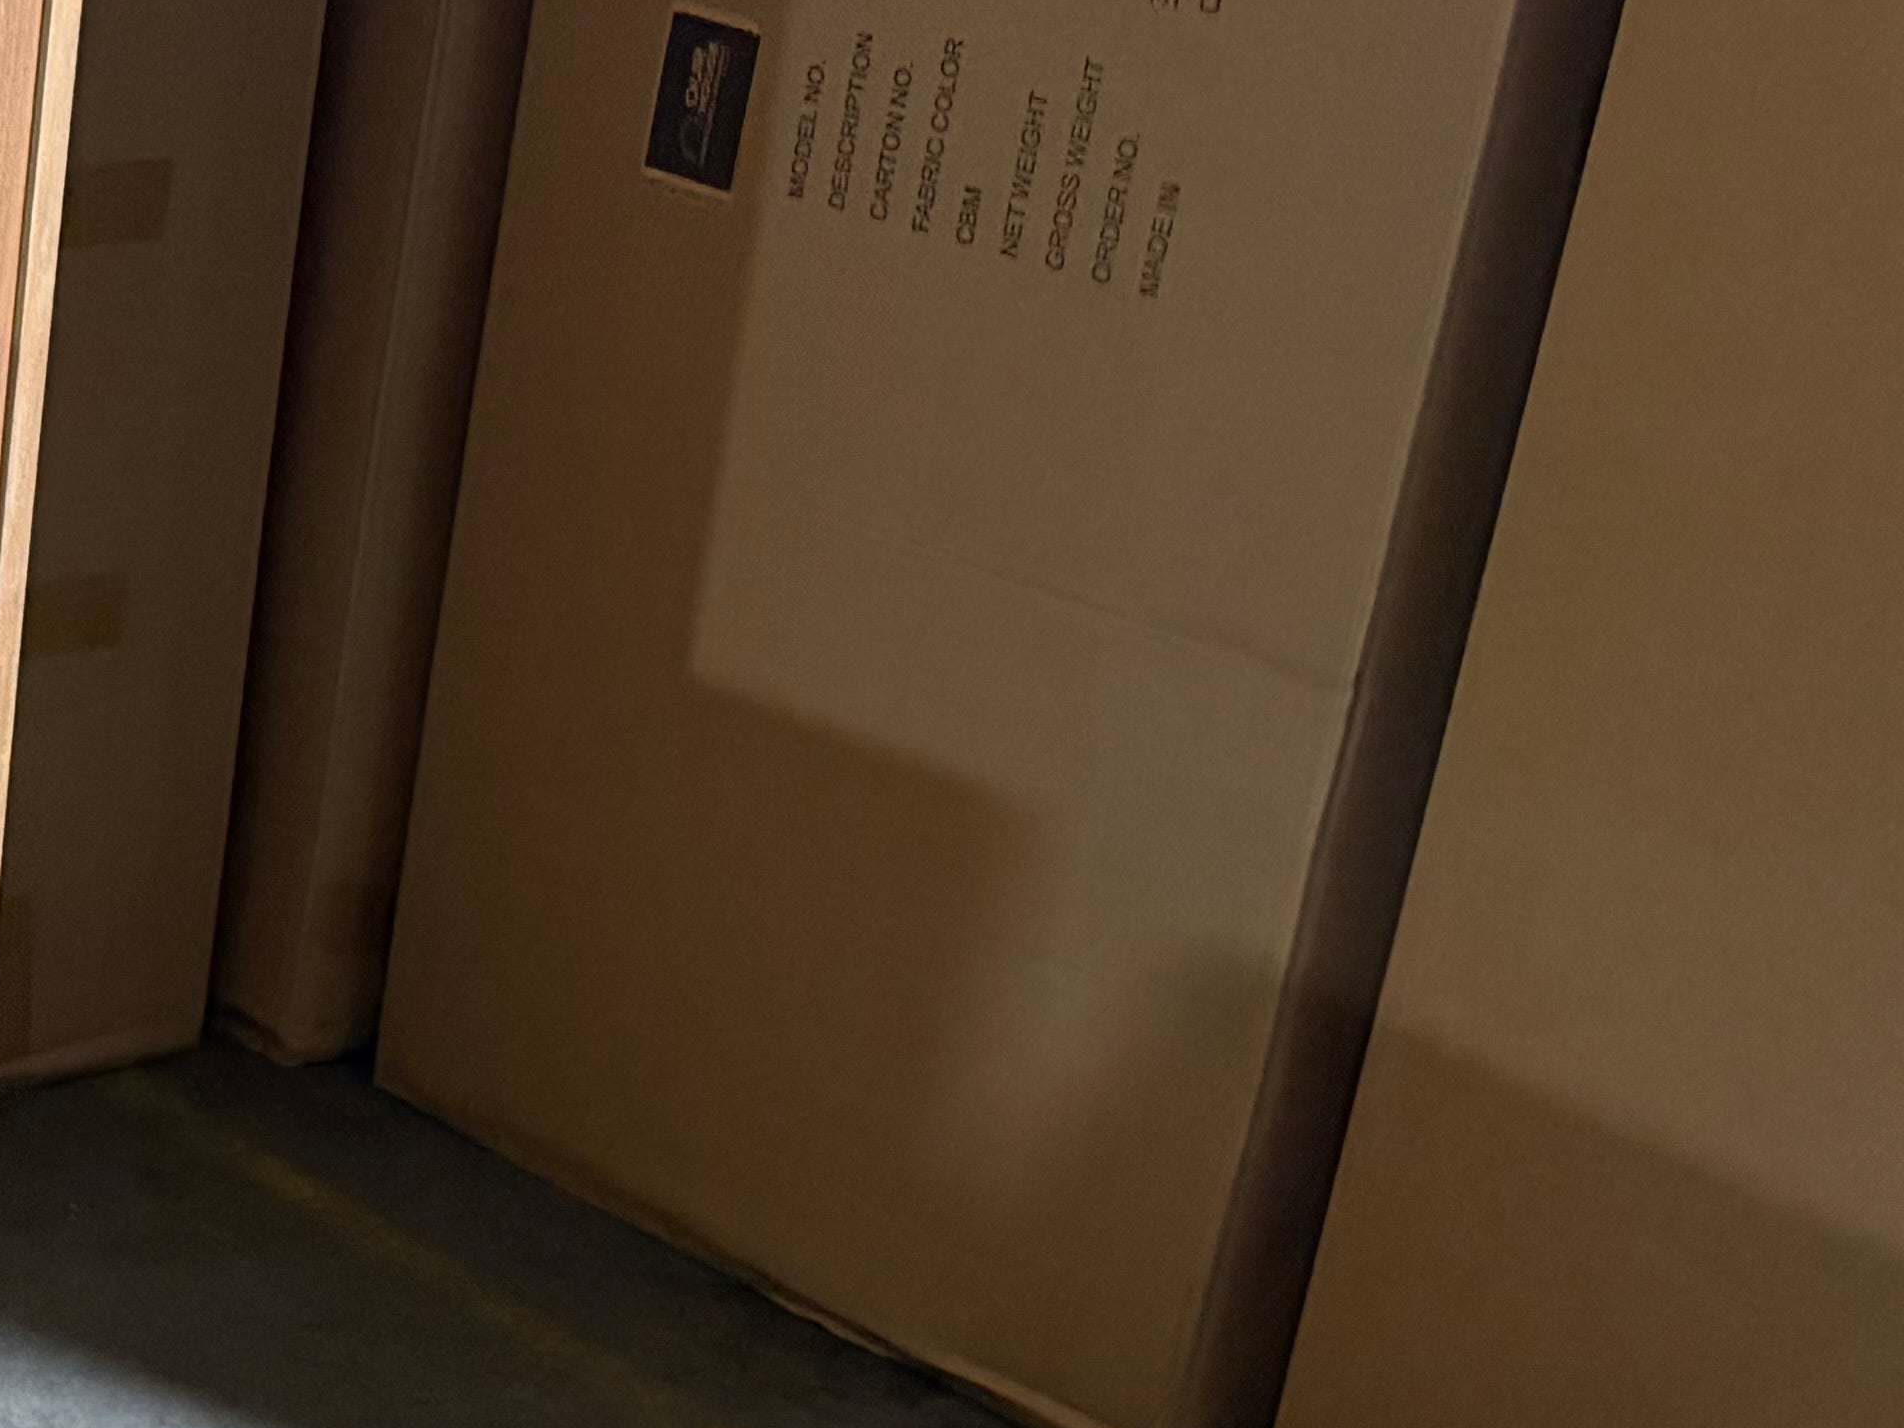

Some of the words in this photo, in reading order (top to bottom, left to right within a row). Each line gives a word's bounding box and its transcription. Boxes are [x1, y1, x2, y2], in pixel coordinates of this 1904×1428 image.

[788, 110, 818, 199] MODEL
[804, 60, 827, 104] NO.
[828, 31, 874, 212] DESCRIPTION
[869, 111, 905, 221] CARTON
[890, 60, 914, 109] NO.
[911, 138, 945, 235] FABRIC
[931, 37, 963, 133] COLOR
[1011, 89, 1048, 200] WEIGHT
[1045, 173, 1080, 271] GROSS
[1065, 55, 1103, 168] WEIGHT
[956, 184, 982, 245] CBM
[1000, 202, 1026, 259] NET
[1092, 186, 1128, 285] ORDER
[1139, 216, 1175, 298] MADE
